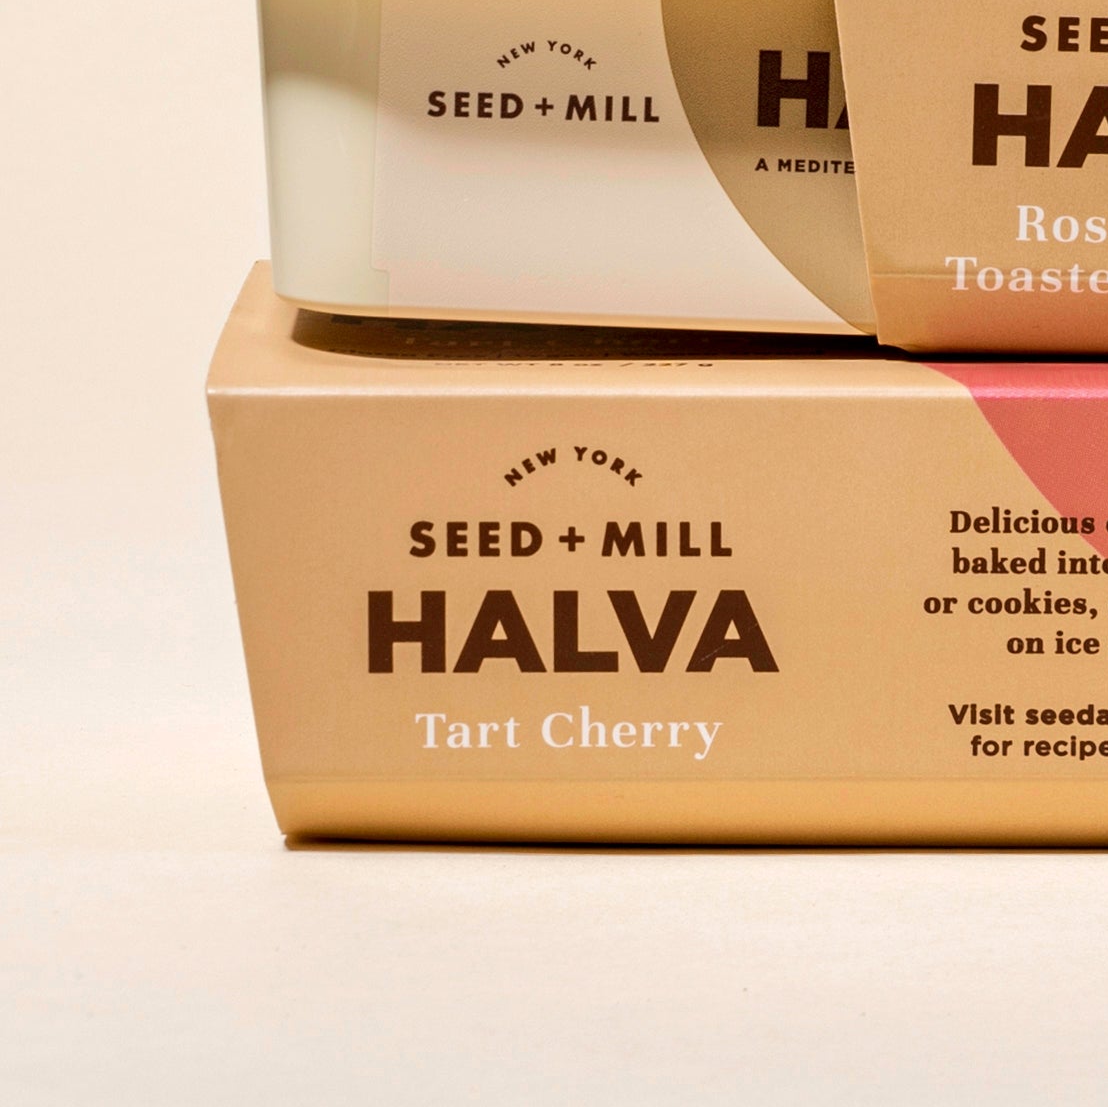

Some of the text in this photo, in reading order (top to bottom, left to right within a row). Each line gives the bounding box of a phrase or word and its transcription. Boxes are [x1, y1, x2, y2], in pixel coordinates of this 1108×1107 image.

[497, 41, 596, 70] NEW YORK
[757, 49, 849, 130] H
[428, 91, 659, 122] SEED + MILL
[755, 158, 768, 171] A
[504, 446, 642, 486] NEW YORK
[950, 507, 1095, 534] Delicious
[410, 521, 732, 557] SEED + MILL
[952, 547, 1046, 574] baked
[924, 597, 957, 614] or
[968, 588, 1097, 619] cookies,
[368, 590, 779, 673] HALVA
[1007, 638, 1044, 654] on
[1055, 631, 1099, 654] ice
[949, 704, 1014, 725] Visit
[415, 706, 722, 760] Tart Cherry
[971, 735, 1012, 756] for
